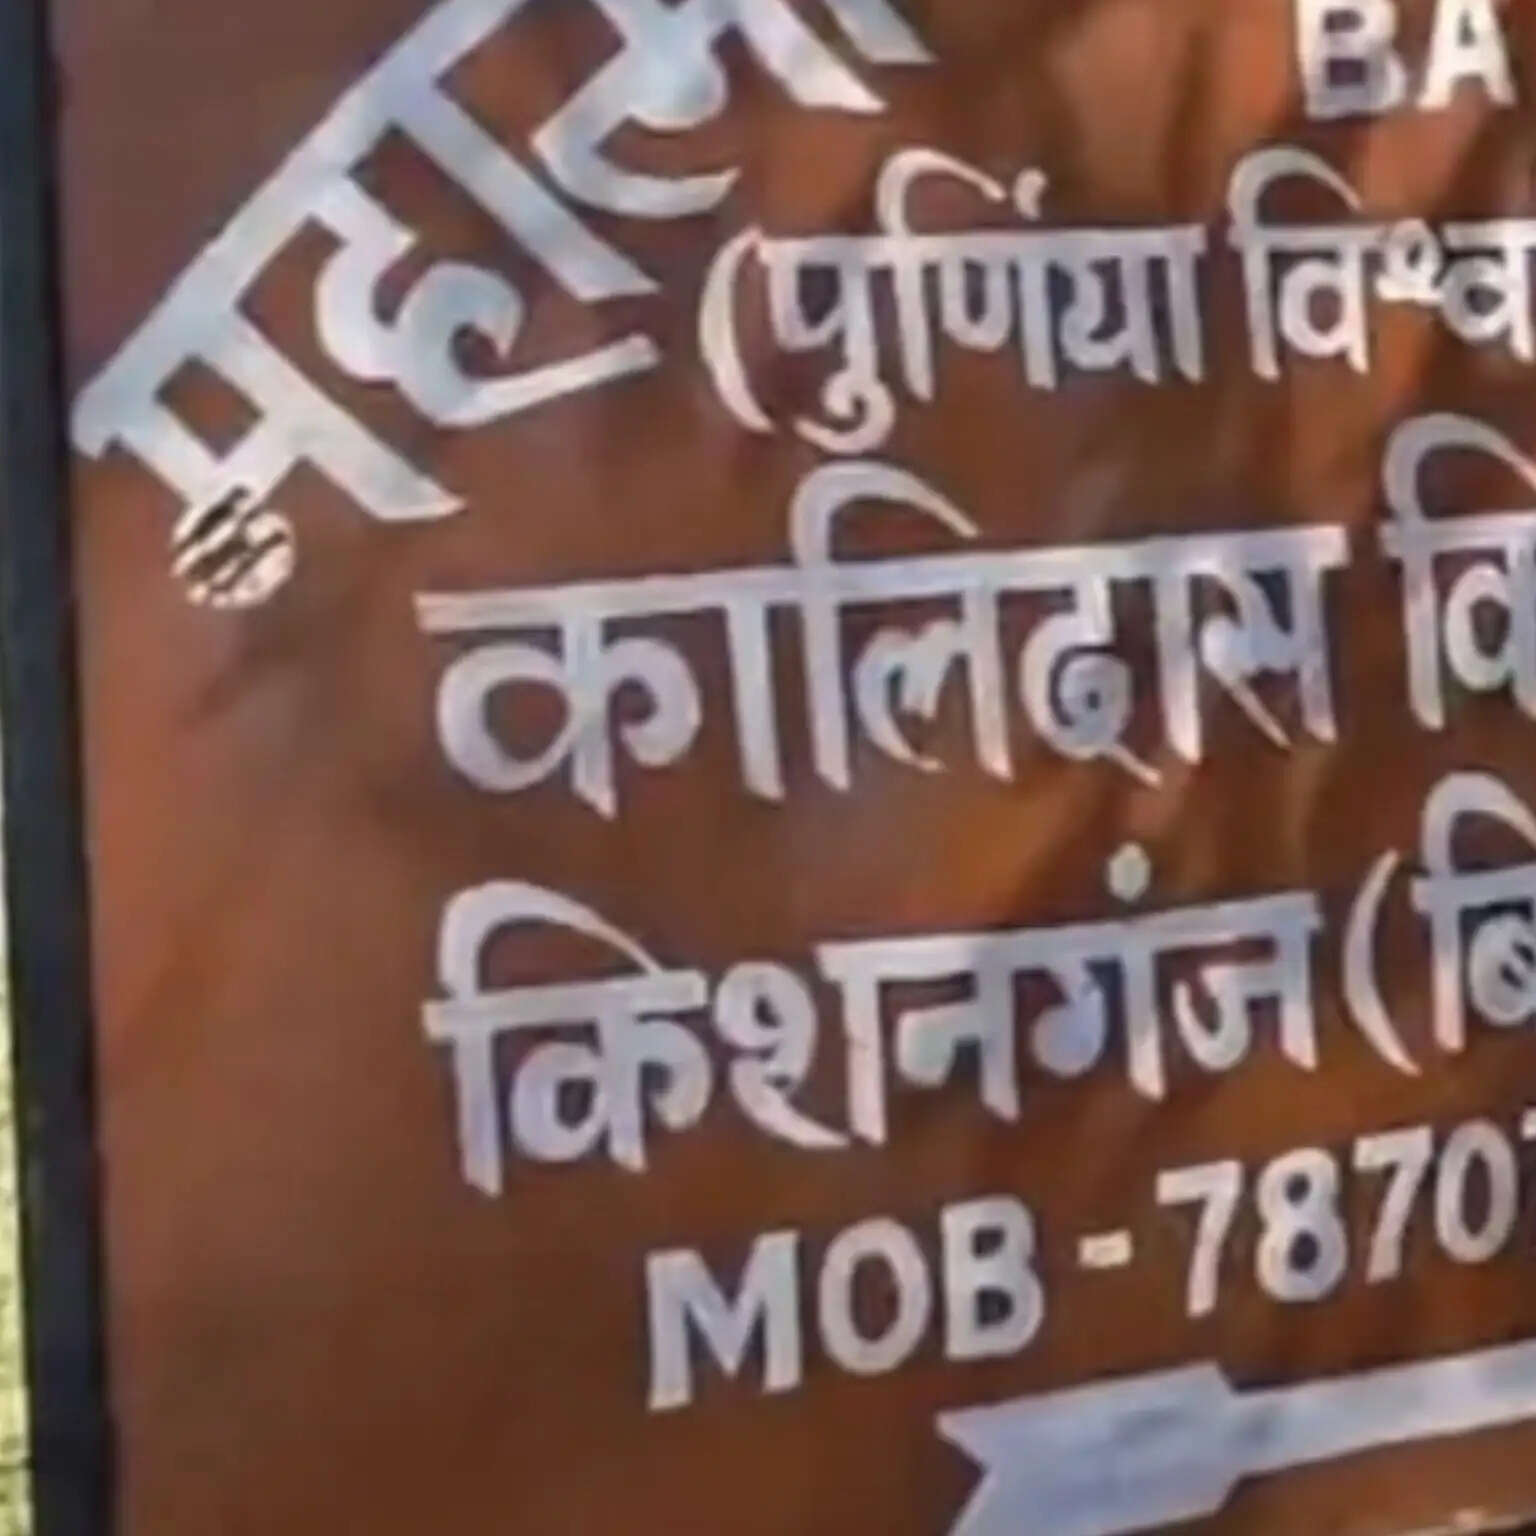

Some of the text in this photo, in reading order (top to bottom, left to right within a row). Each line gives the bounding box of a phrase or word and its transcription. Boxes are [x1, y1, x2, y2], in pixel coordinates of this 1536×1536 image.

[414, 462, 1345, 819] कालिदास
[422, 842, 1321, 1198] किशनगंज
[645, 1194, 1043, 1413] MOB
